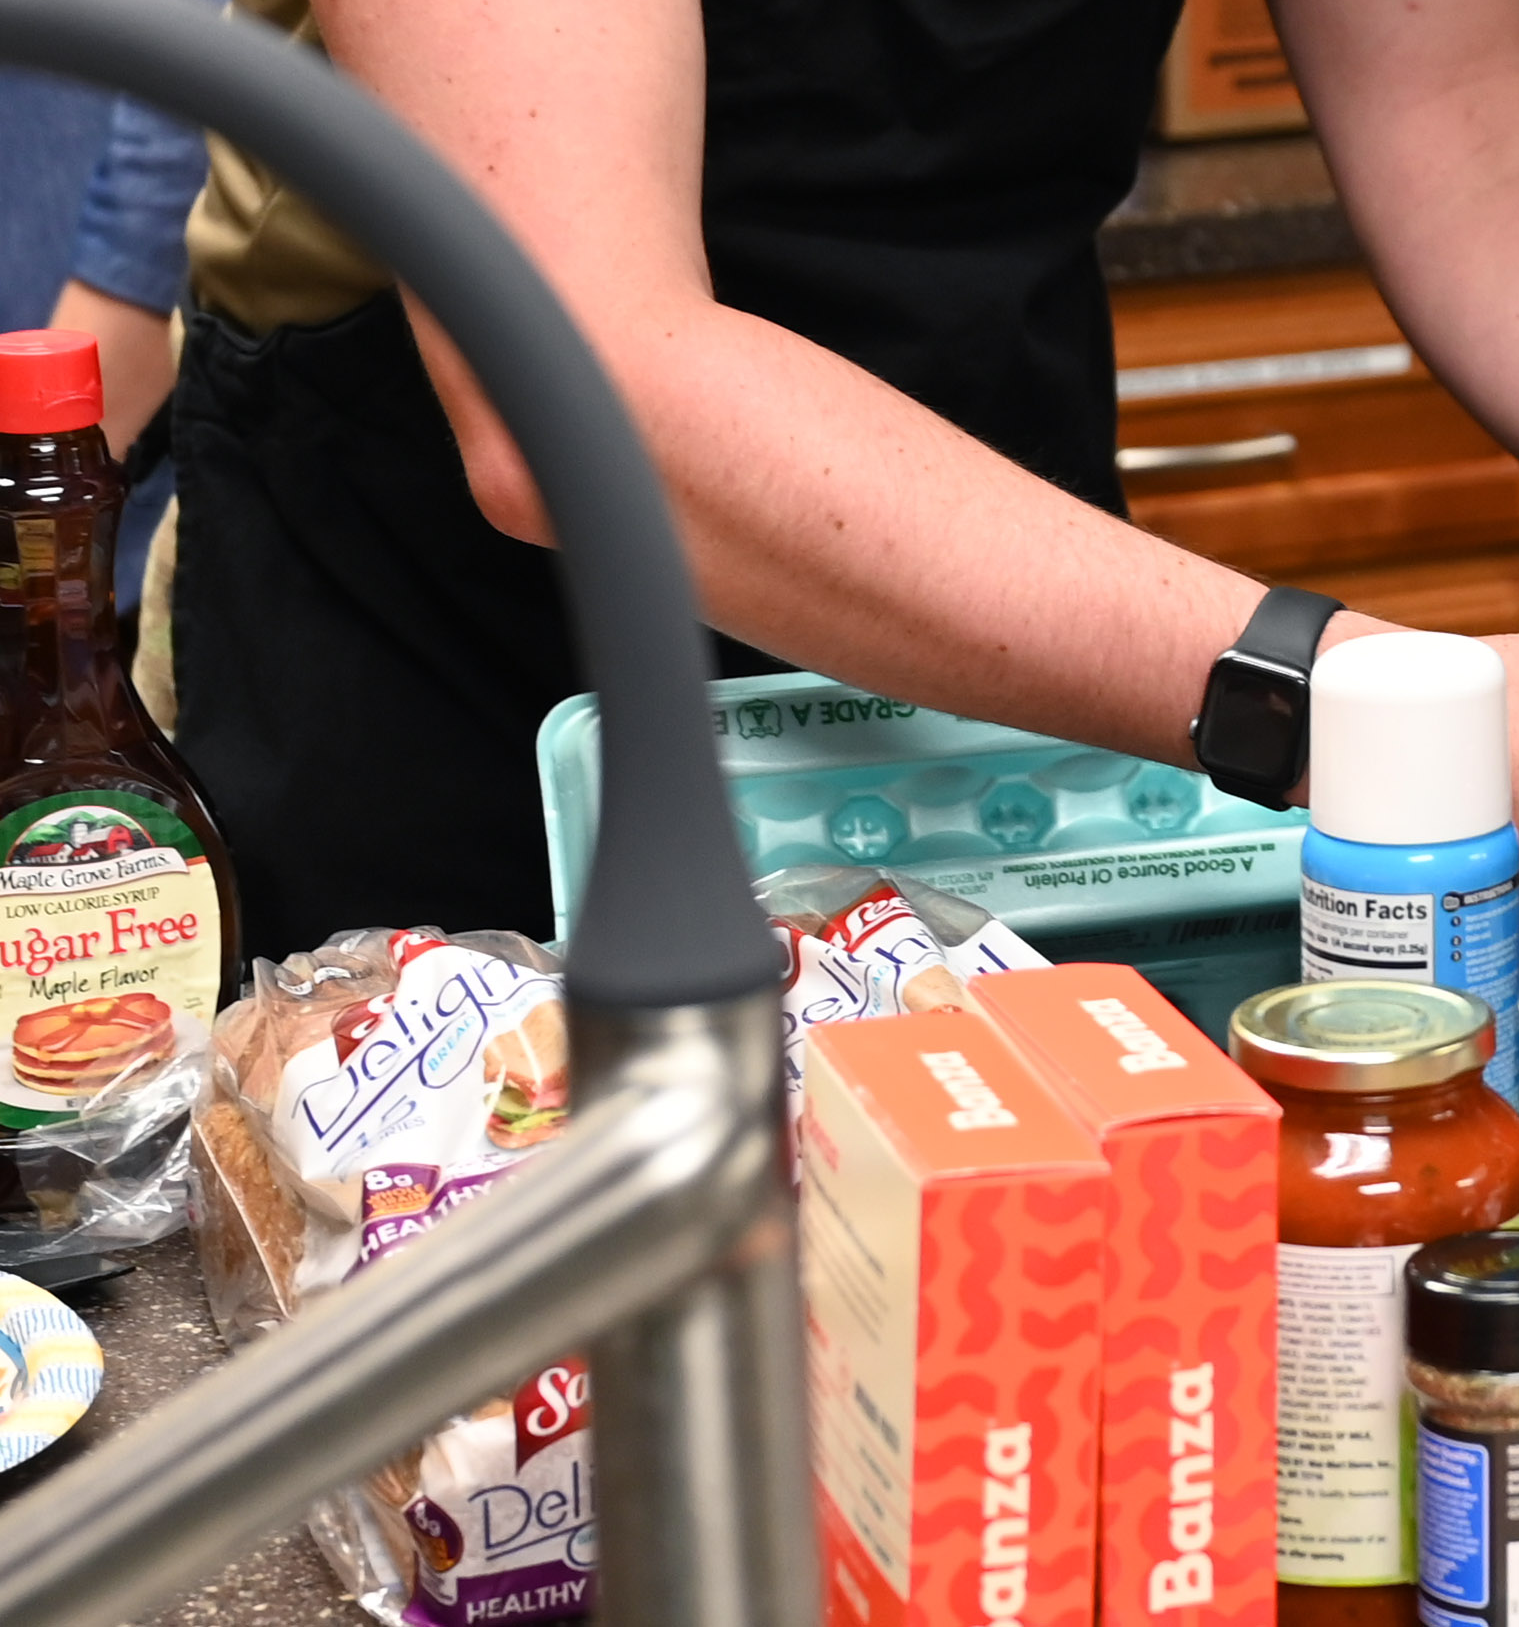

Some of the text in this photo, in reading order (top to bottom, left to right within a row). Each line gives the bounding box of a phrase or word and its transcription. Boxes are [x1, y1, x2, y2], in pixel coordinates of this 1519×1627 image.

[5, 886, 161, 919] LOW CALORIE SYRUP
[61, 865, 113, 887] Grove
[1024, 857, 1253, 889] A Good Source Of Protein
[1364, 898, 1428, 921] Facts
[0, 907, 198, 977] ugar Free
[28, 965, 160, 1002] Maple Flavor
[1077, 997, 1189, 1075] Banza
[918, 1050, 1020, 1132] Banza
[526, 1366, 590, 1437] Sa
[1148, 1361, 1215, 1614] Banza
[974, 1420, 1032, 1627] anza
[466, 1576, 588, 1624] HEALTHY
